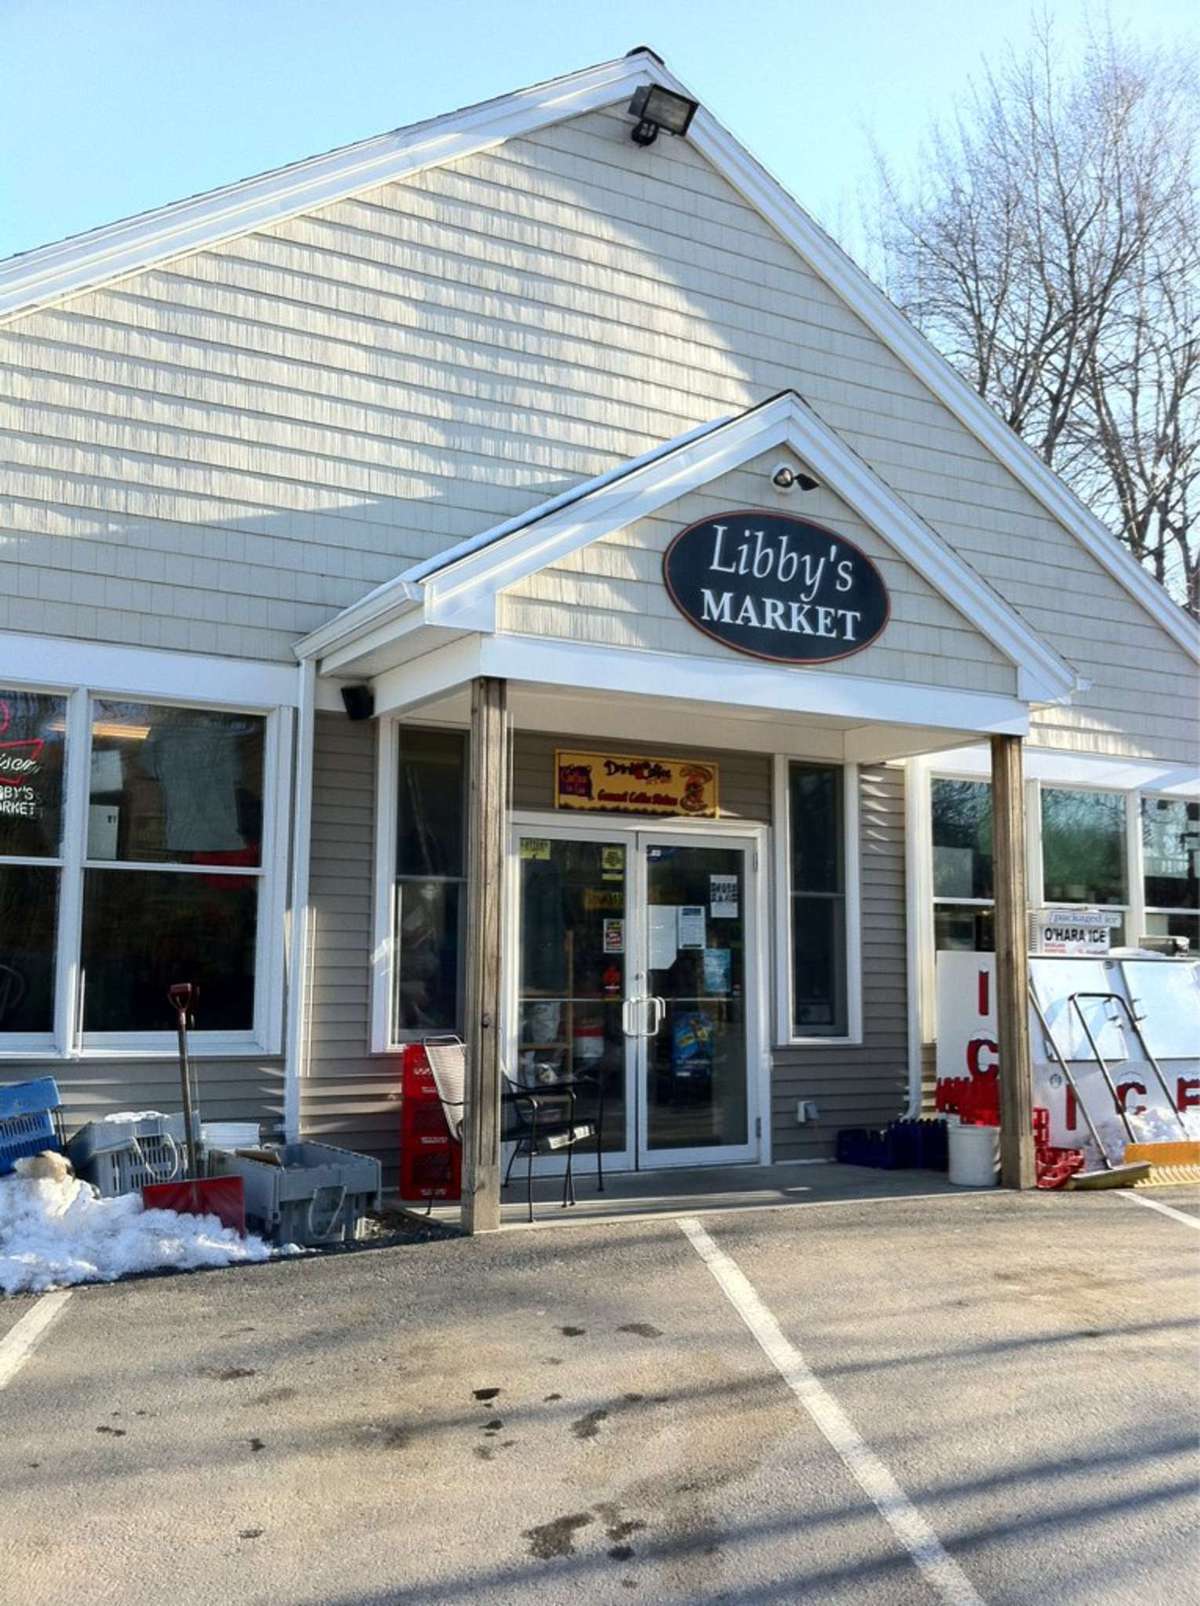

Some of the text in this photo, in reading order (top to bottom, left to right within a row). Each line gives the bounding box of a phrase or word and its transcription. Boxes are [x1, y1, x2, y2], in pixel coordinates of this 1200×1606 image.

[710, 524, 853, 601] Libby's
[701, 588, 861, 641] MARKET
[0, 800, 36, 815] RKET
[1044, 927, 1107, 943] O'HARA ICE
